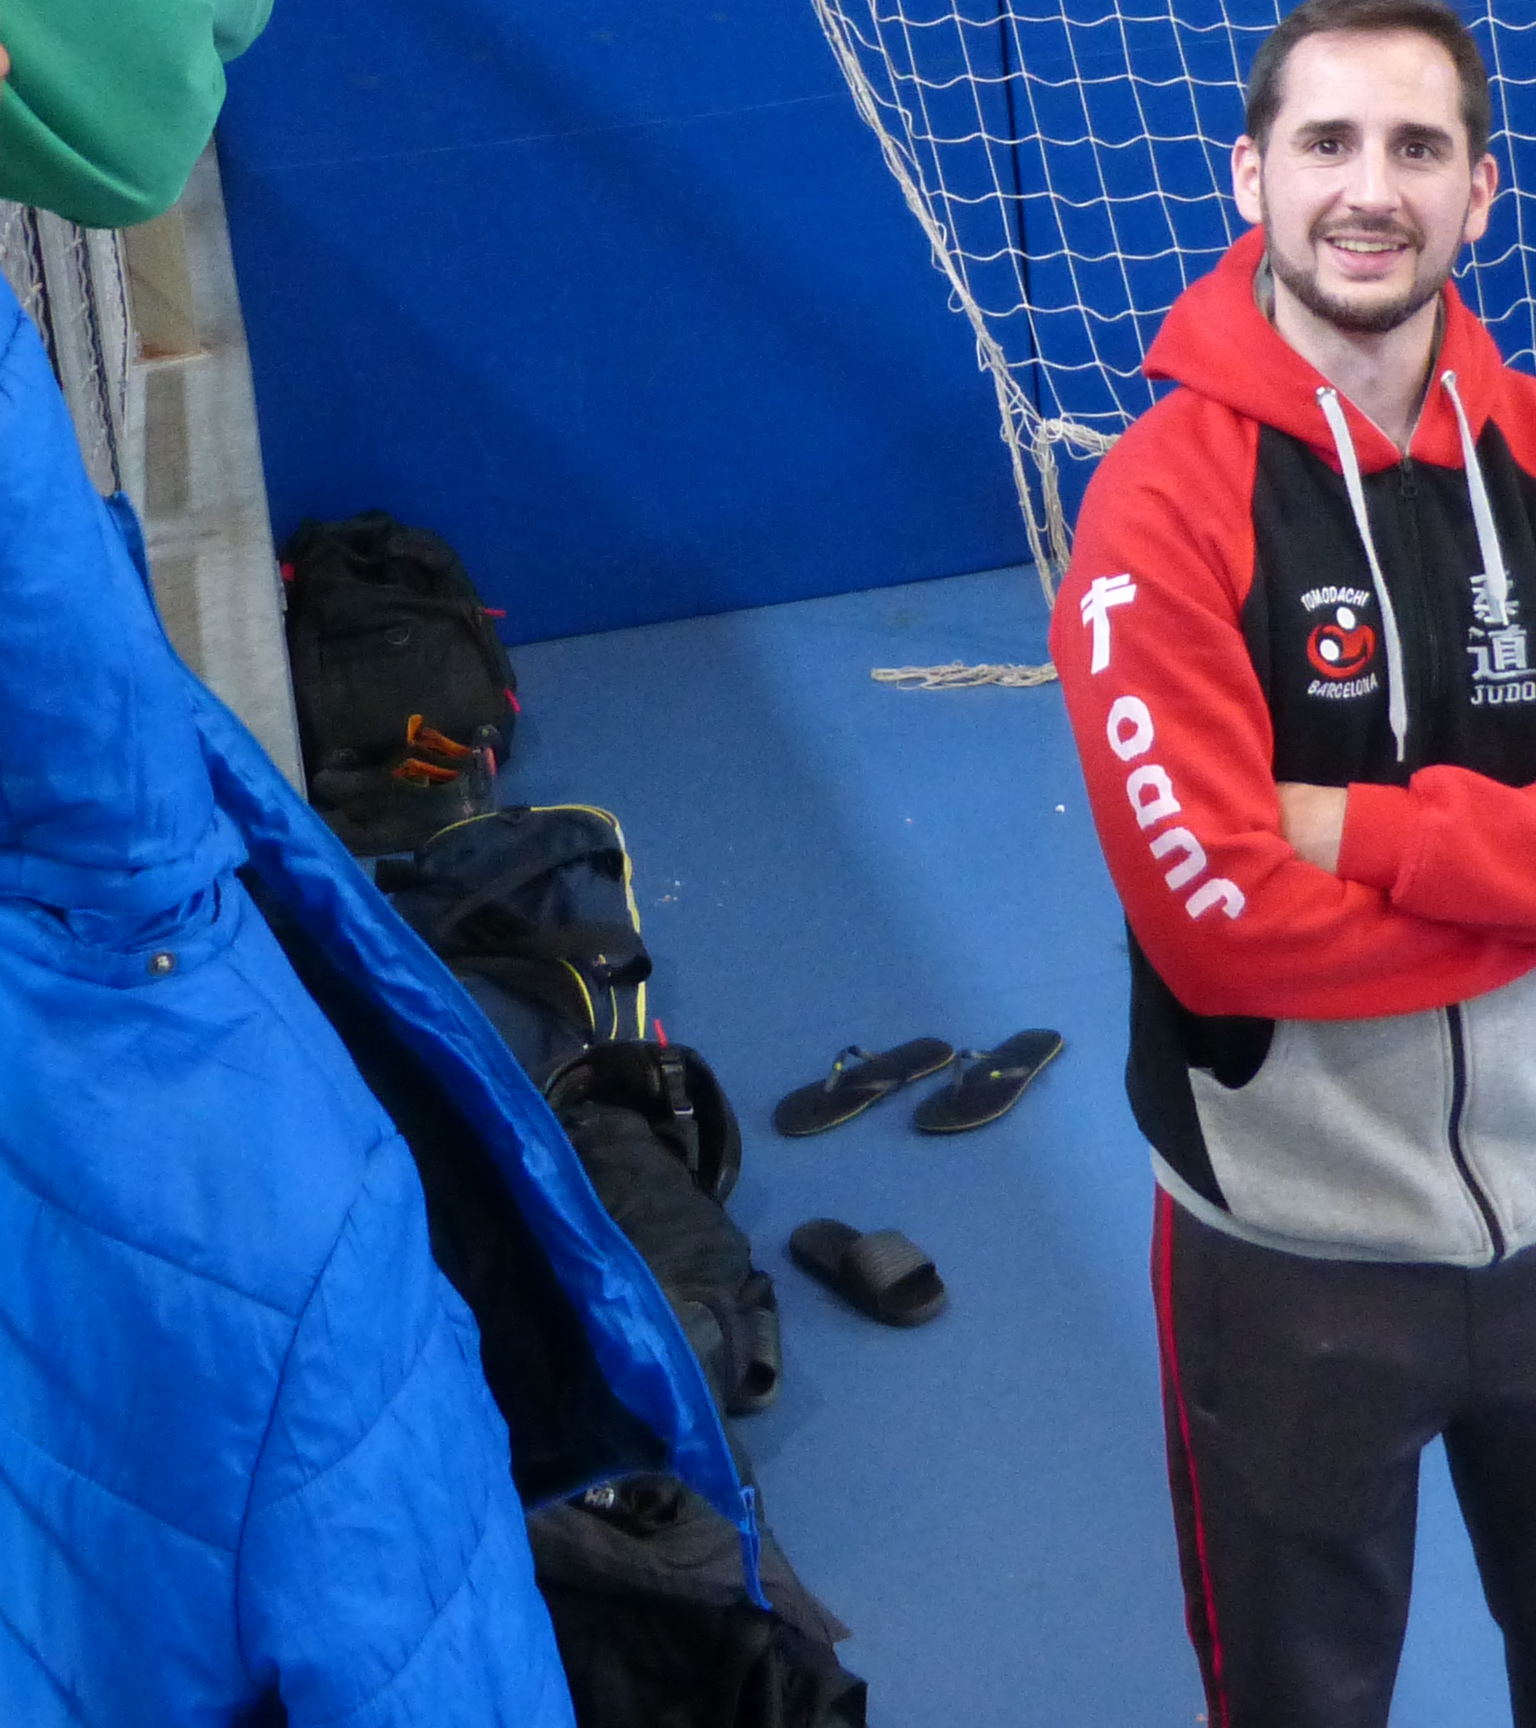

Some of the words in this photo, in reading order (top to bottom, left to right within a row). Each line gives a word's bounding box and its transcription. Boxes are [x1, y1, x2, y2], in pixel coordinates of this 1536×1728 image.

[1301, 586, 1370, 612] TOMODACHI
[1307, 672, 1379, 699] BARCELONA
[1470, 680, 1536, 704] JUDO
